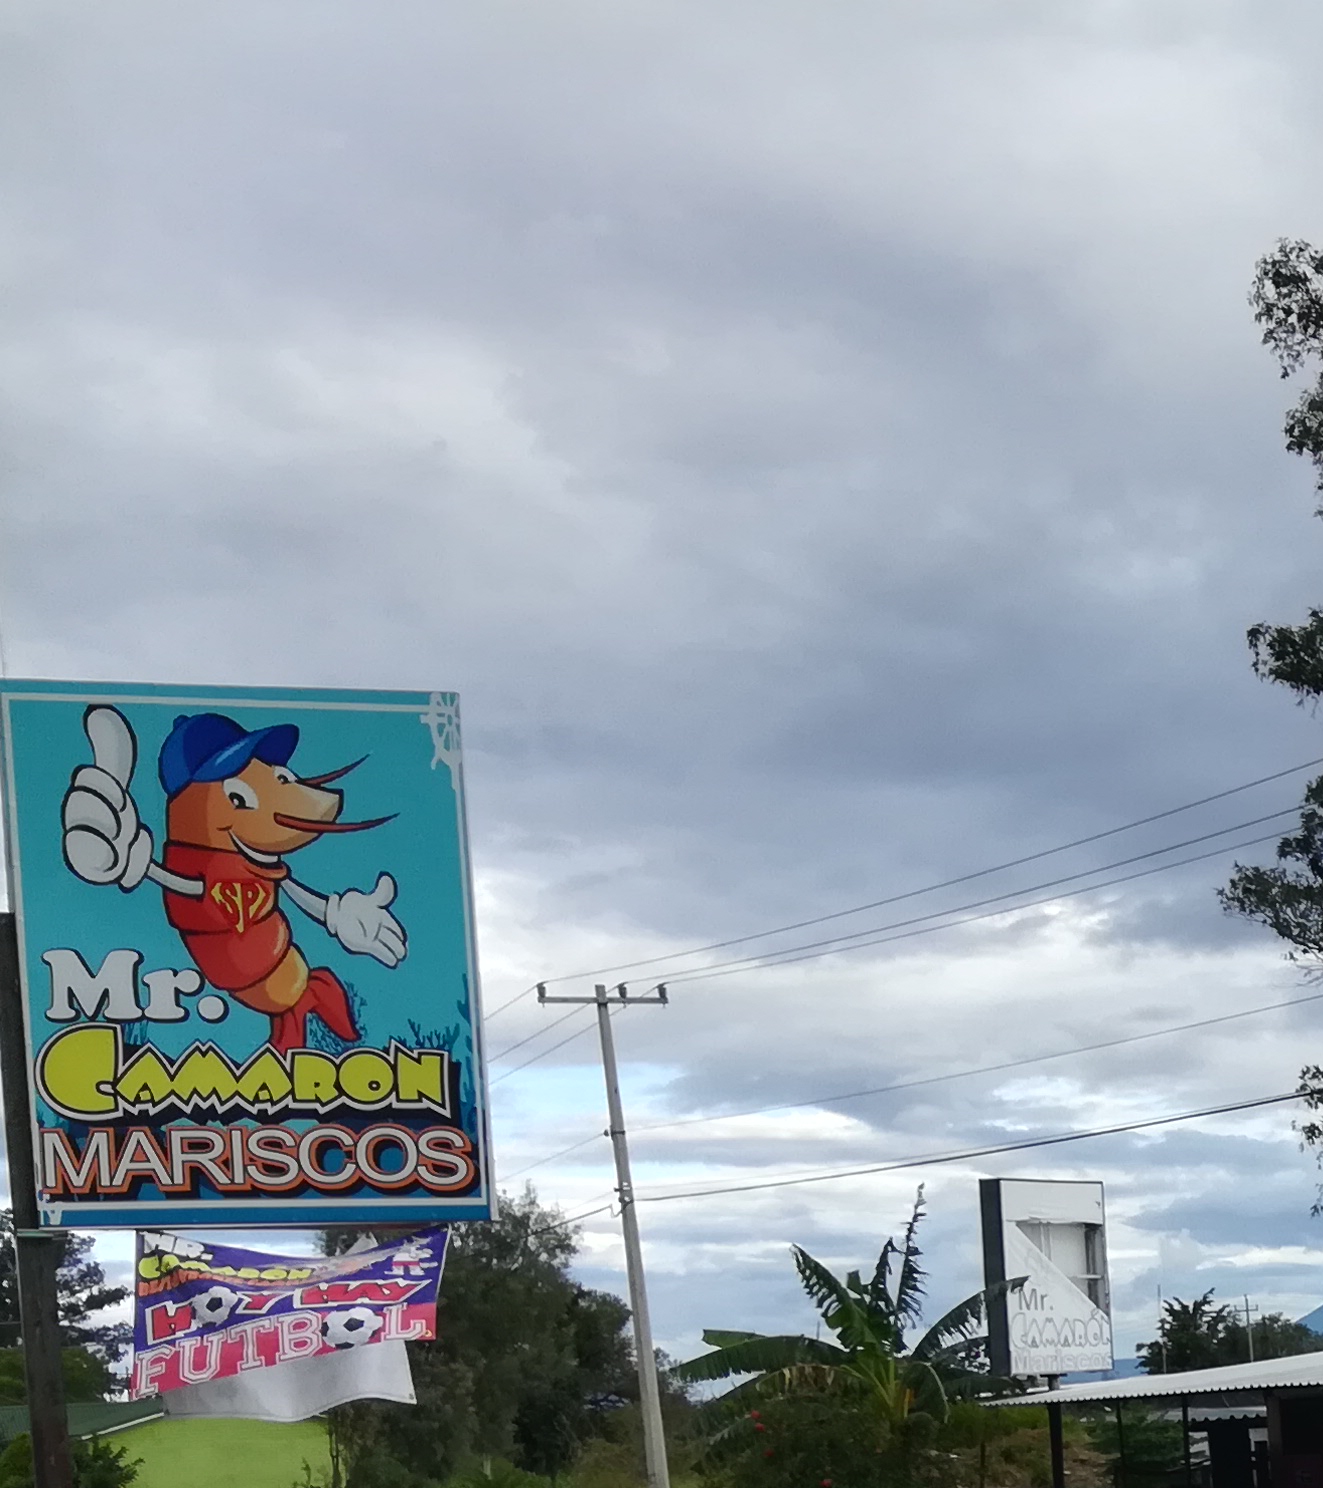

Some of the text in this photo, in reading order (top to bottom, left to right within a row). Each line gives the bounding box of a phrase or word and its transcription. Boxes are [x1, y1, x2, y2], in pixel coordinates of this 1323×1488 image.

[42, 948, 229, 1023] Mr.
[38, 1023, 450, 1118] CAMARON
[40, 1125, 474, 1195] MARISCOS
[146, 1286, 293, 1345] HOY
[1018, 1288, 1054, 1311] Mr.
[134, 1303, 426, 1399] FUTBOL
